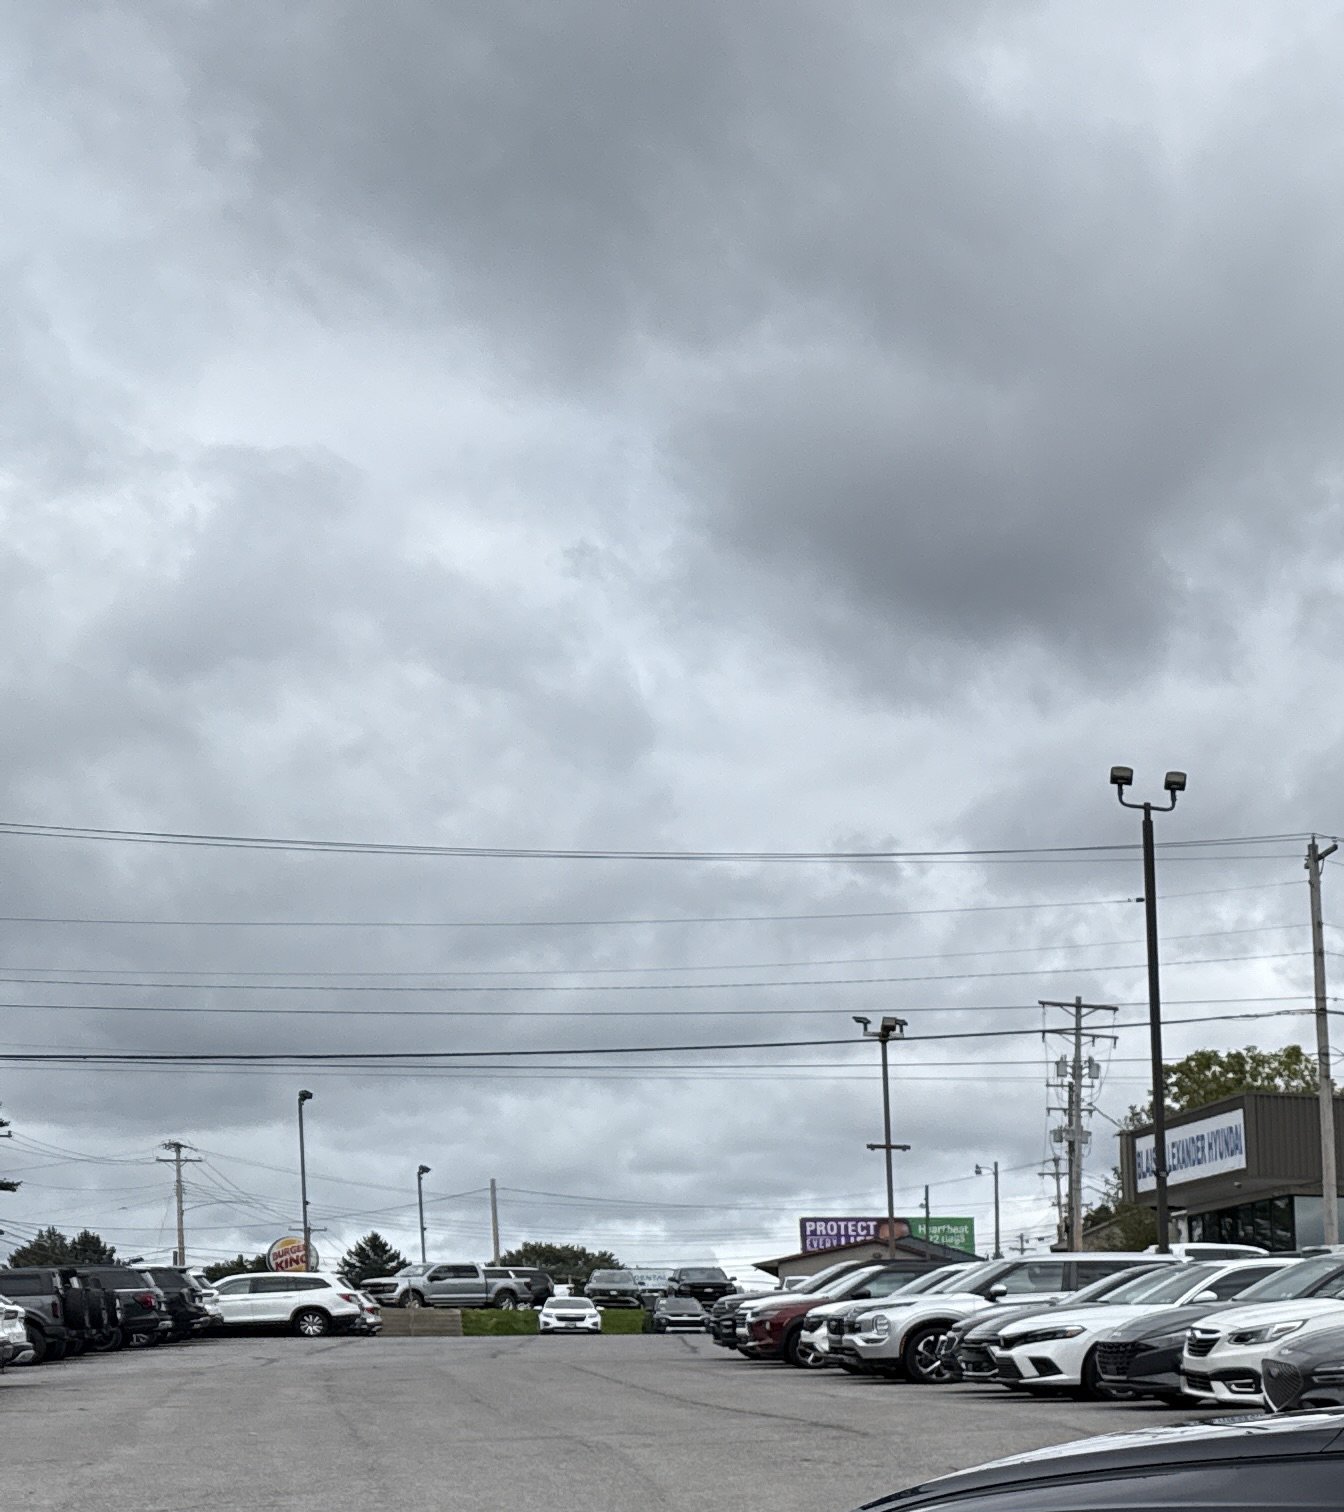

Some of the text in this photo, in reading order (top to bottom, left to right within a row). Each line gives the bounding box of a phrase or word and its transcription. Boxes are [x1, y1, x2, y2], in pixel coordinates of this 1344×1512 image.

[1207, 1123, 1243, 1163] HYUNDAI
[805, 1221, 877, 1236] PROTECT
[272, 1244, 307, 1261] BURGE
